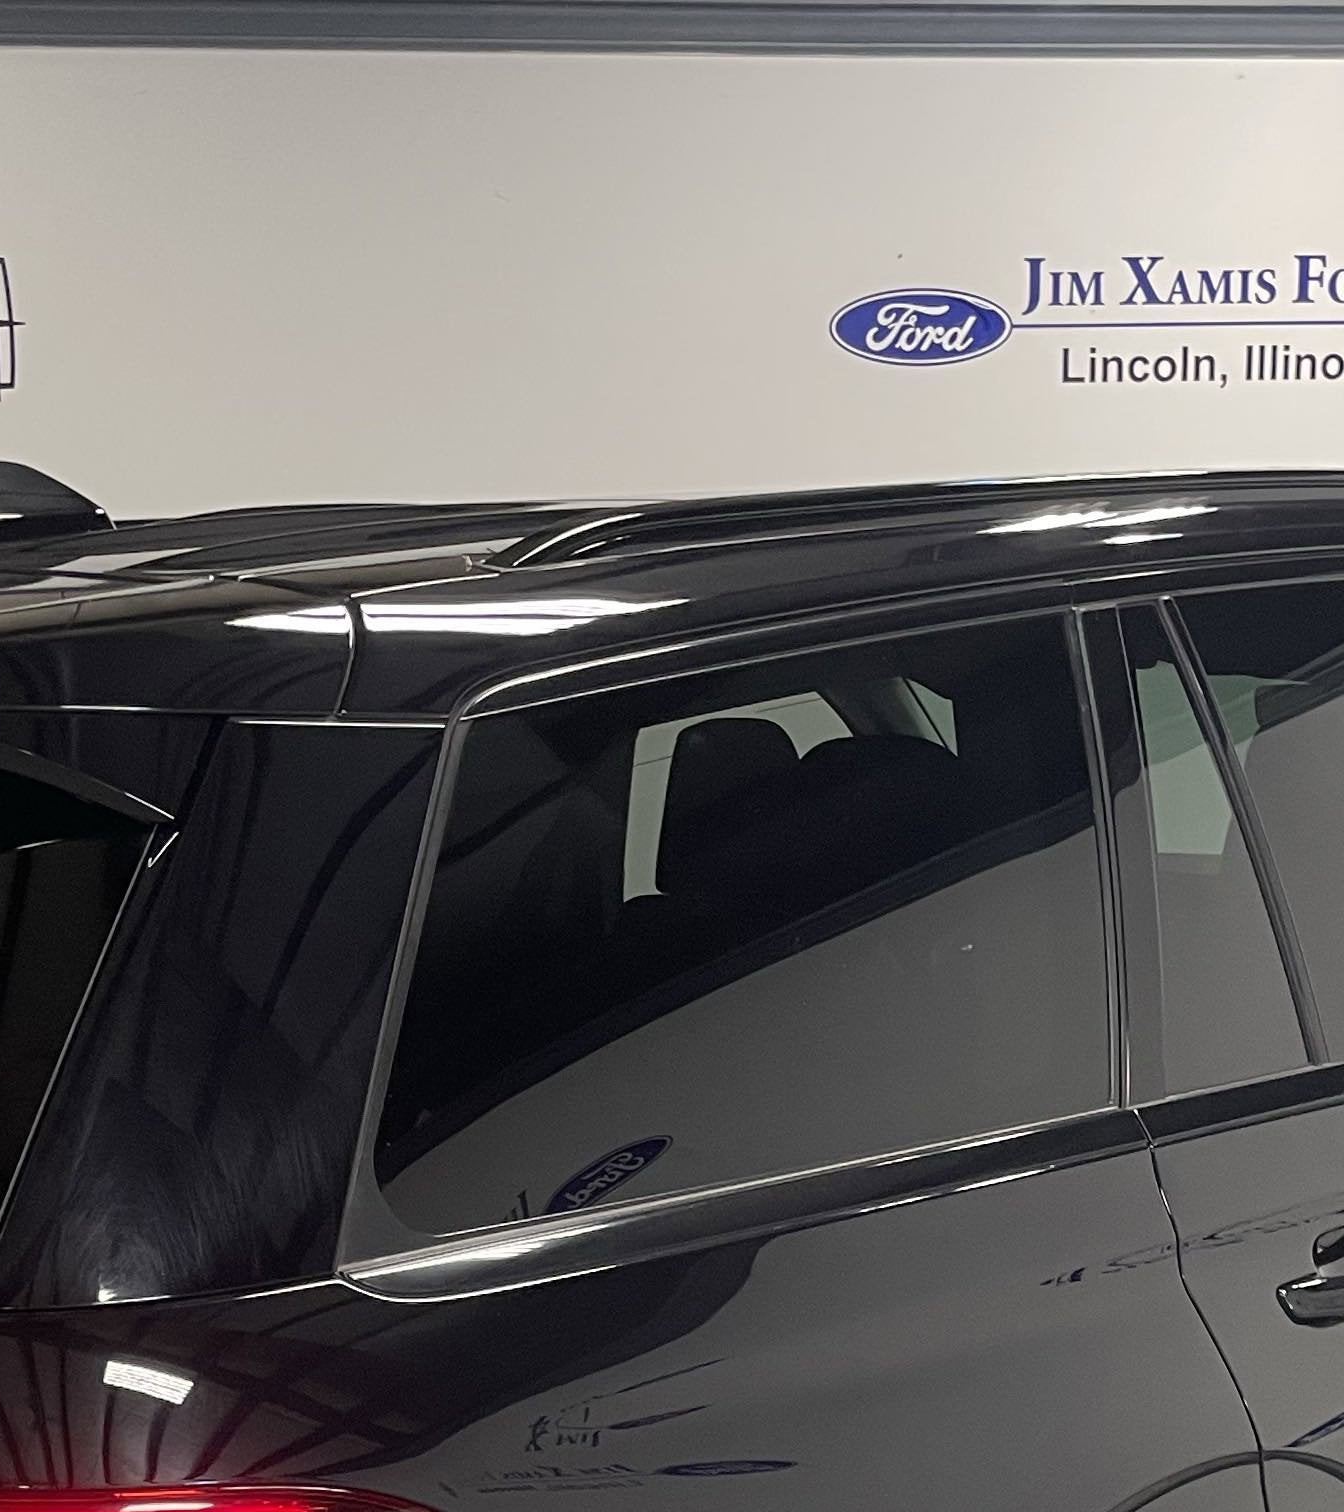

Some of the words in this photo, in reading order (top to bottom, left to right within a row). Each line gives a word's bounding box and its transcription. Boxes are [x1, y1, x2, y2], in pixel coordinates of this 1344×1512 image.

[1022, 257, 1105, 316] JIM
[1119, 256, 1277, 306] XAMIS
[866, 303, 974, 354] Ford
[1062, 346, 1227, 389] Lincoln,
